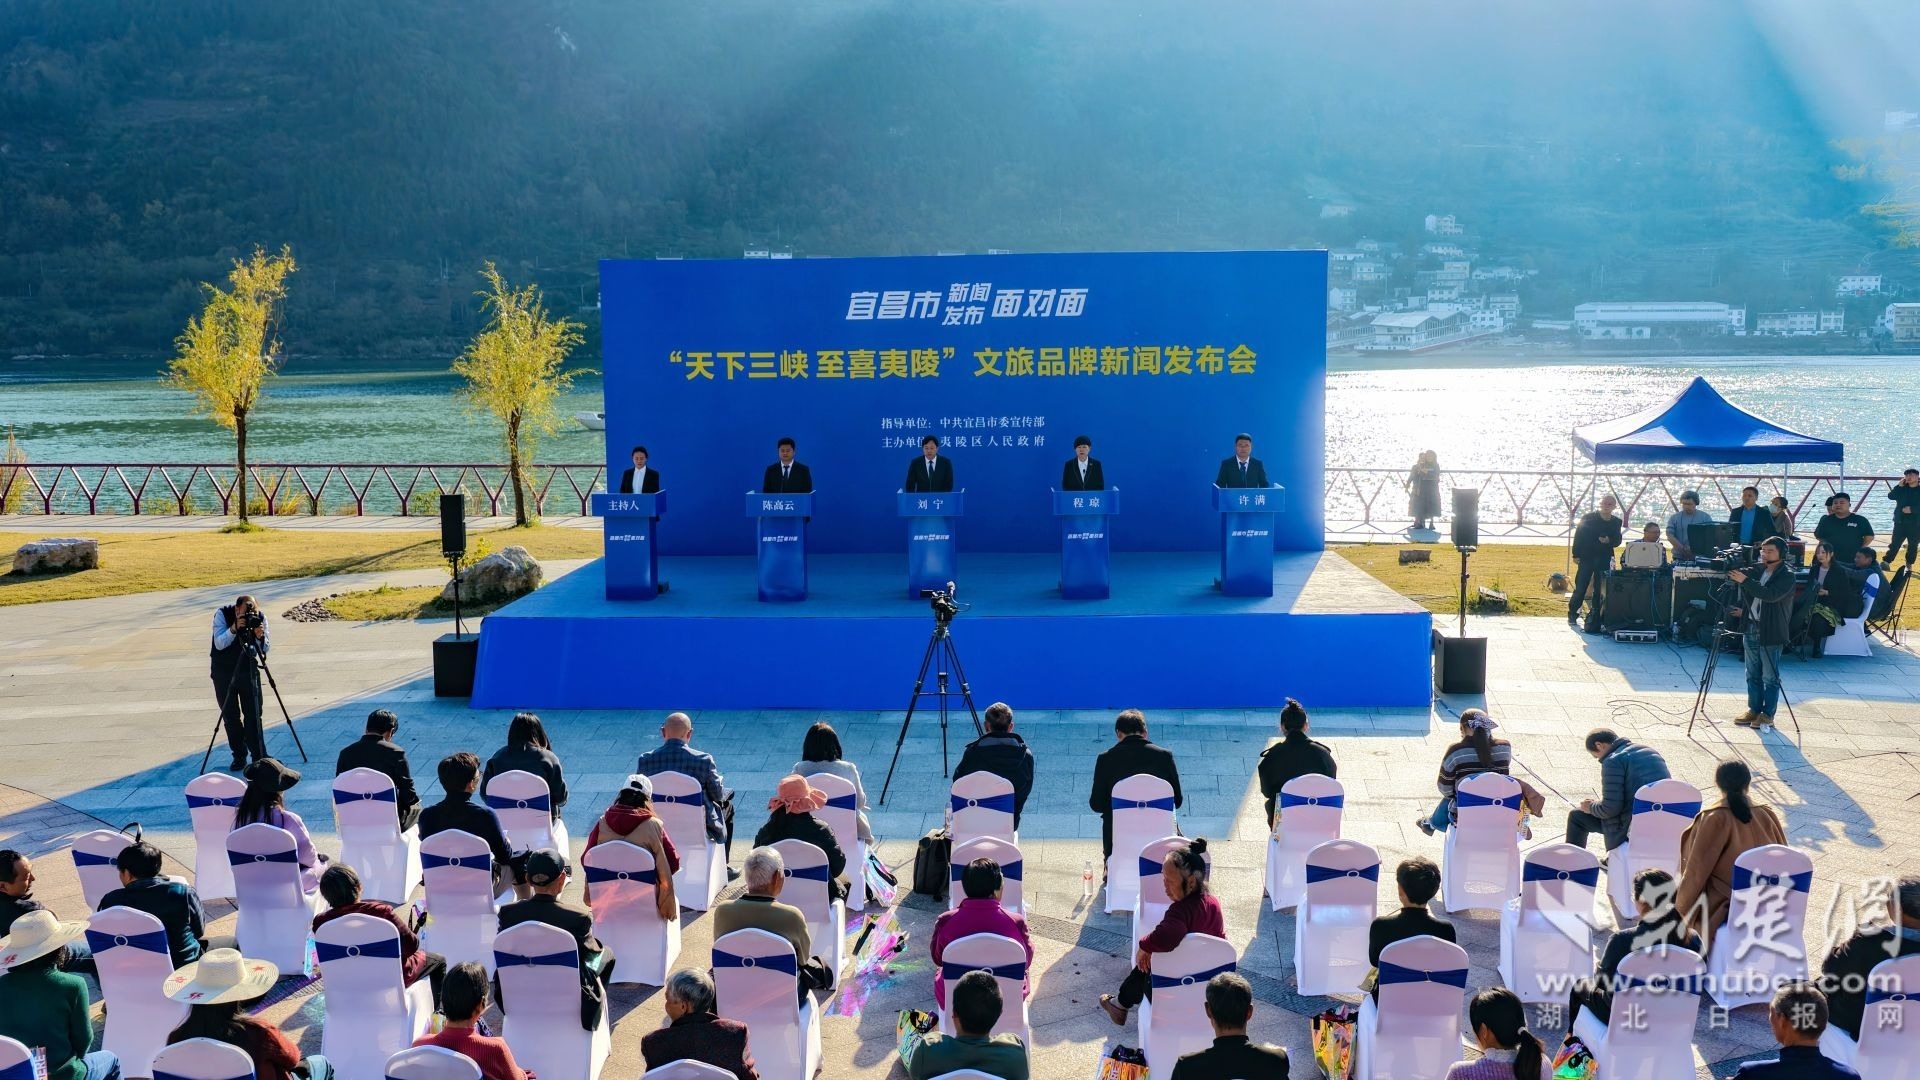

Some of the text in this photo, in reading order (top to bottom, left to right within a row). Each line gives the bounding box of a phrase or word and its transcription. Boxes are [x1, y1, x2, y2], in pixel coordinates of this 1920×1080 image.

[846, 282, 1089, 326] 宜昌市 新闻 发布 面对面
[973, 344, 1257, 377] 文旅品牌新闻发布会
[608, 500, 639, 511] 主持人
[762, 500, 794, 511] 陈高云
